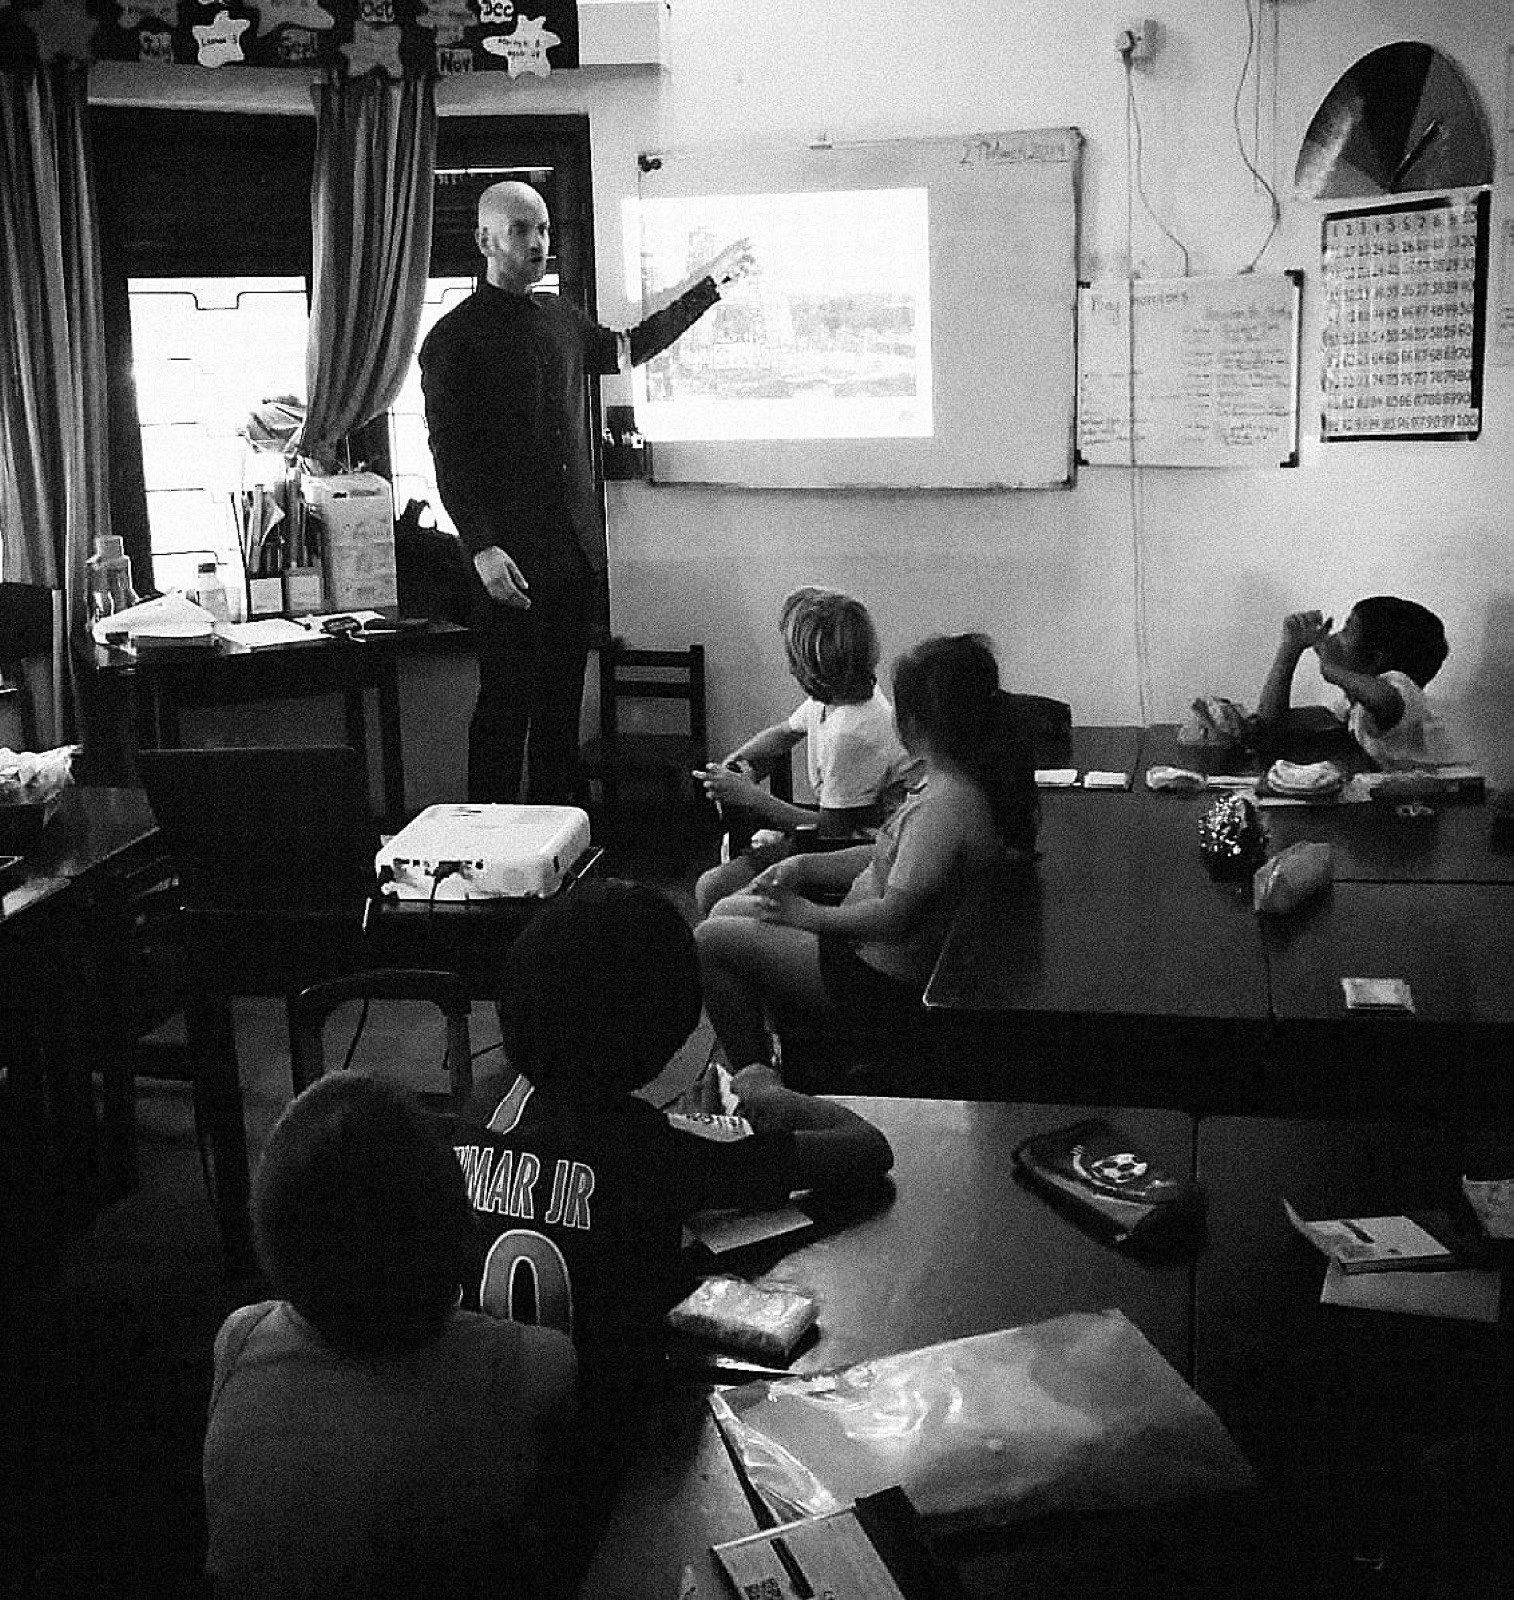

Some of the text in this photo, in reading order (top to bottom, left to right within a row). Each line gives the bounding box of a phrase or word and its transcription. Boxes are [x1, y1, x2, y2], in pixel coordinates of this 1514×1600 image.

[482, 0, 513, 17] Dec
[439, 51, 471, 74] Nov
[544, 1159, 595, 1231] JR
